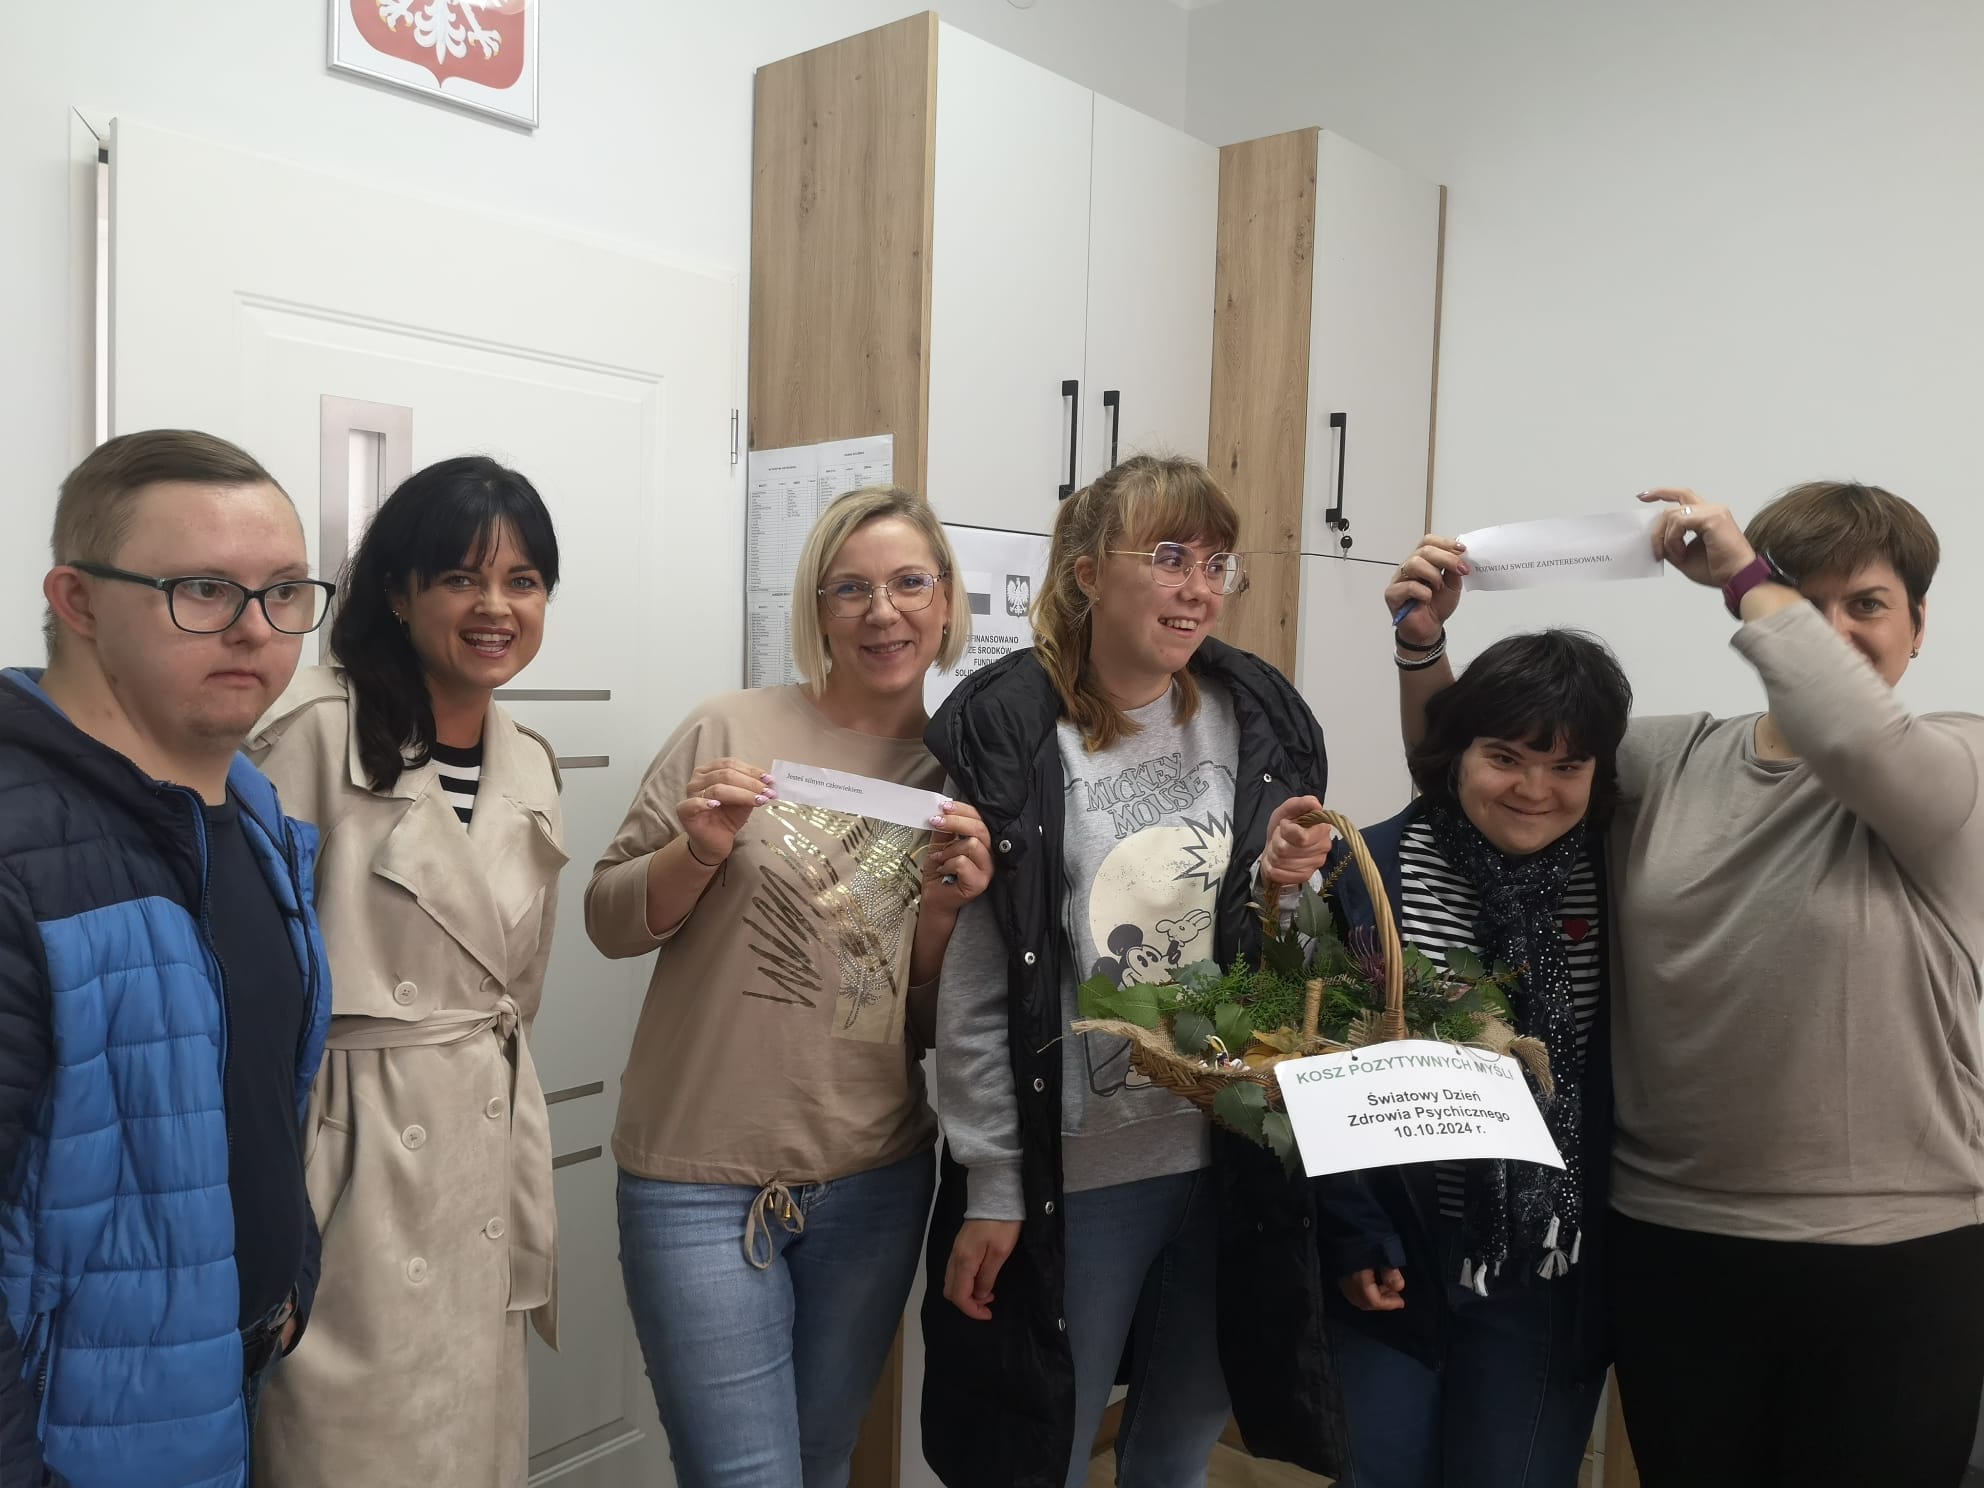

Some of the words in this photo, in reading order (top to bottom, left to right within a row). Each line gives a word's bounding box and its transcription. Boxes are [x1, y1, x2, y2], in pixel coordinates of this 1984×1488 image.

[1510, 562, 1535, 570] SWOJE
[1536, 554, 1613, 568] ZAINTERESOWANIA.
[968, 646, 976, 654] ZE
[977, 644, 1012, 655] ŚRODKÓW
[955, 668, 974, 677] SOLID
[786, 773, 804, 782] Jesteś
[805, 777, 825, 787] silnym
[825, 782, 864, 794] człowiekiem.
[1085, 753, 1181, 812] MICKEY
[1107, 766, 1210, 839] MOUSE
[1296, 1066, 1346, 1084] KOSZ
[1348, 1055, 1472, 1076] POZYTYWNYCH
[1474, 1061, 1514, 1080] MYŚLI
[1367, 1091, 1438, 1106] Światowy
[1442, 1089, 1481, 1102] Dzień
[1347, 1109, 1411, 1127] Zdrowia
[1414, 1105, 1510, 1122] Psychicznego
[1394, 1122, 1472, 1138] 10.10.2024
[1475, 1125, 1486, 1134] r.
